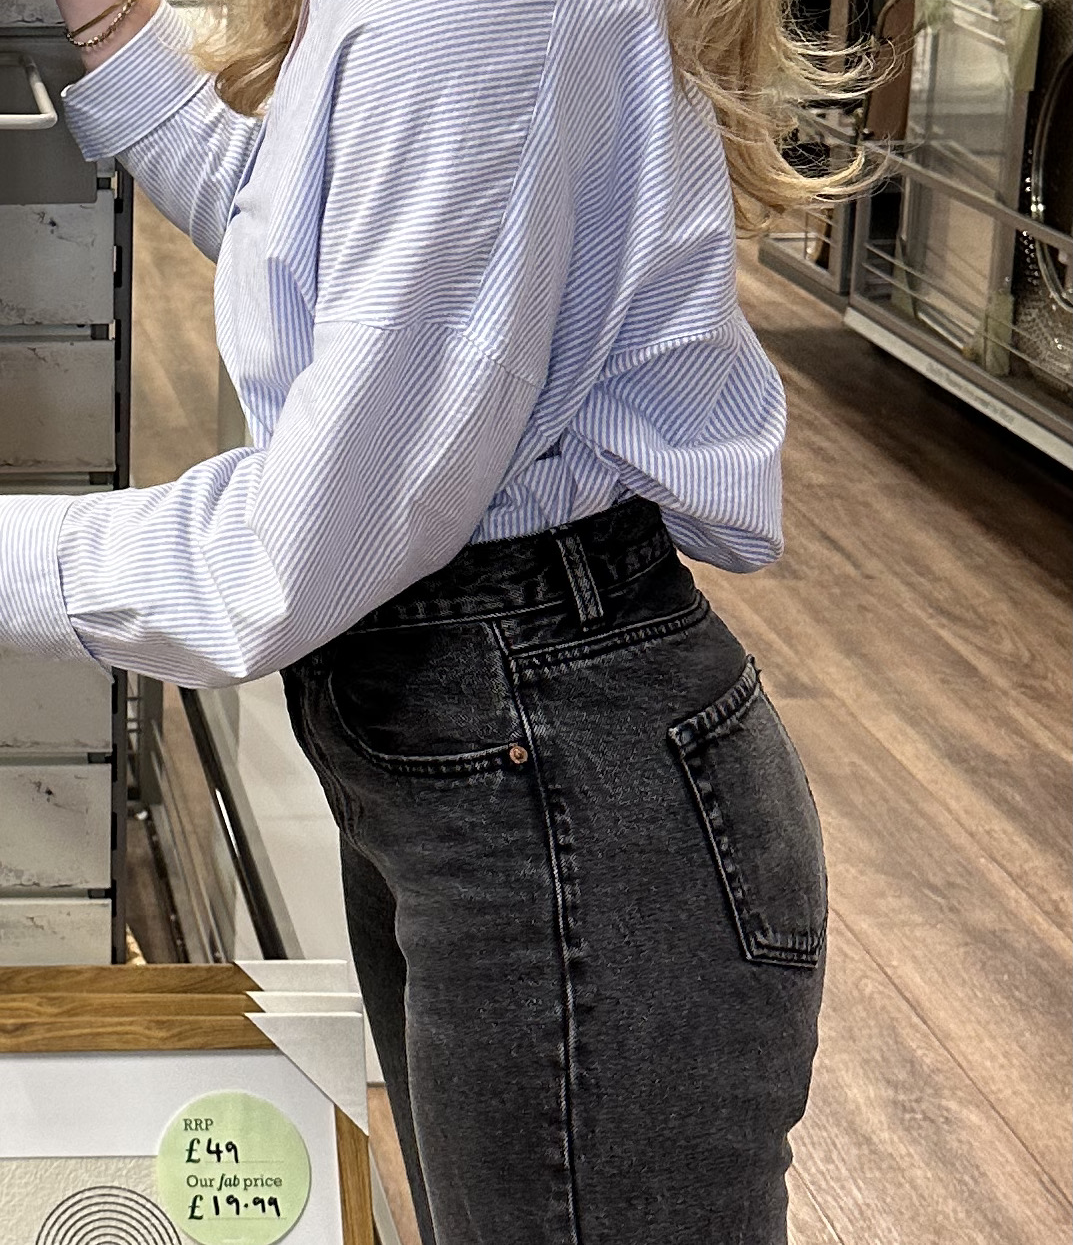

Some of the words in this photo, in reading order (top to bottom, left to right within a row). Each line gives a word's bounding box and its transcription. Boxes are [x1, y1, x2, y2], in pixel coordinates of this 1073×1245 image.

[183, 1118, 214, 1131] RRP
[186, 1175, 215, 1188] Our
[217, 1173, 240, 1192] fab
[243, 1175, 283, 1191] price
